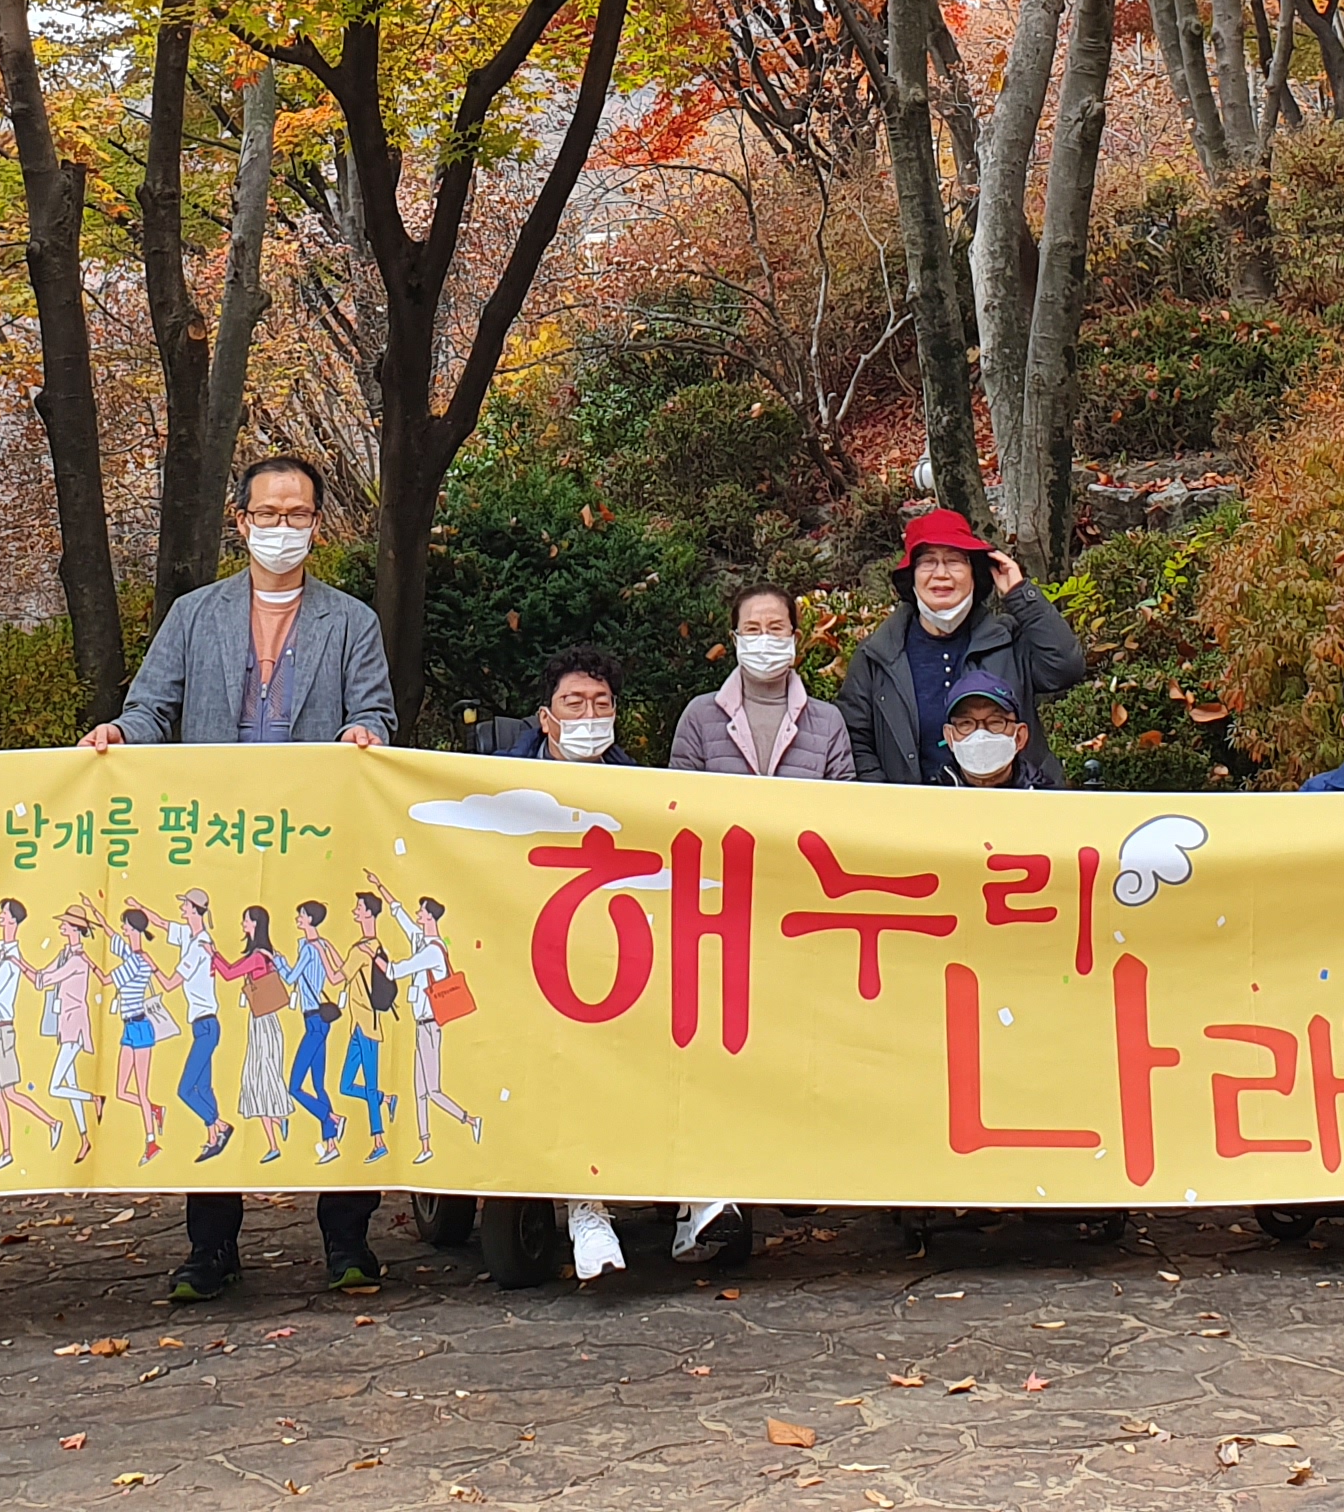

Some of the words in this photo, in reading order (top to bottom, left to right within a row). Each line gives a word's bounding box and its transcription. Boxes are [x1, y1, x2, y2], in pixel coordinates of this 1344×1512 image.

[5, 796, 140, 869] 날개를
[158, 799, 332, 866] 펼쳐라~
[527, 824, 1100, 1056] 해누리
